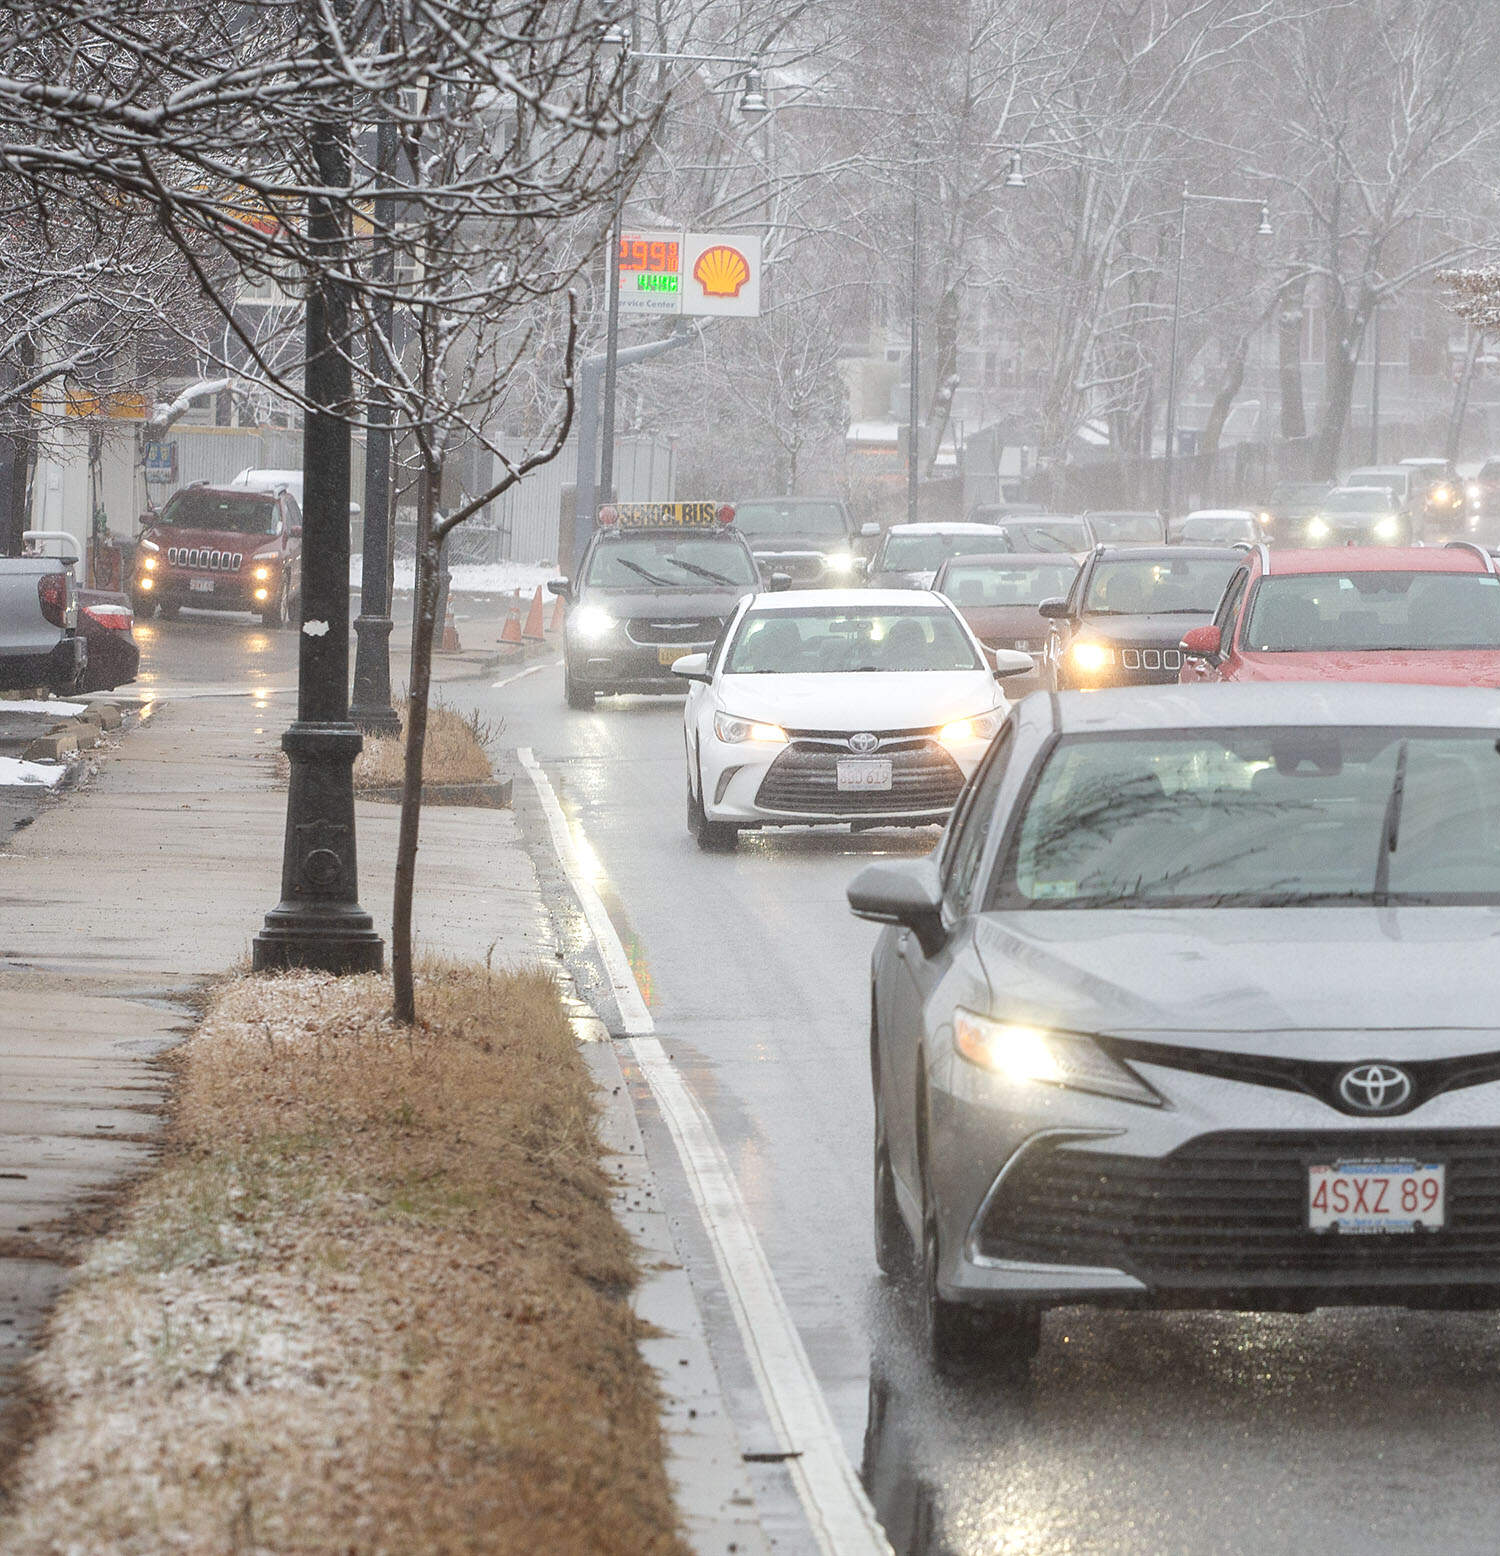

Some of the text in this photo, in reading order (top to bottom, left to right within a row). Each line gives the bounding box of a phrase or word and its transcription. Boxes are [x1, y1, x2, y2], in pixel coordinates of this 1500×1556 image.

[618, 299, 676, 309] ervice Center
[682, 503, 714, 523] BUS
[1312, 1178, 1439, 1214] 4SXZ 89
